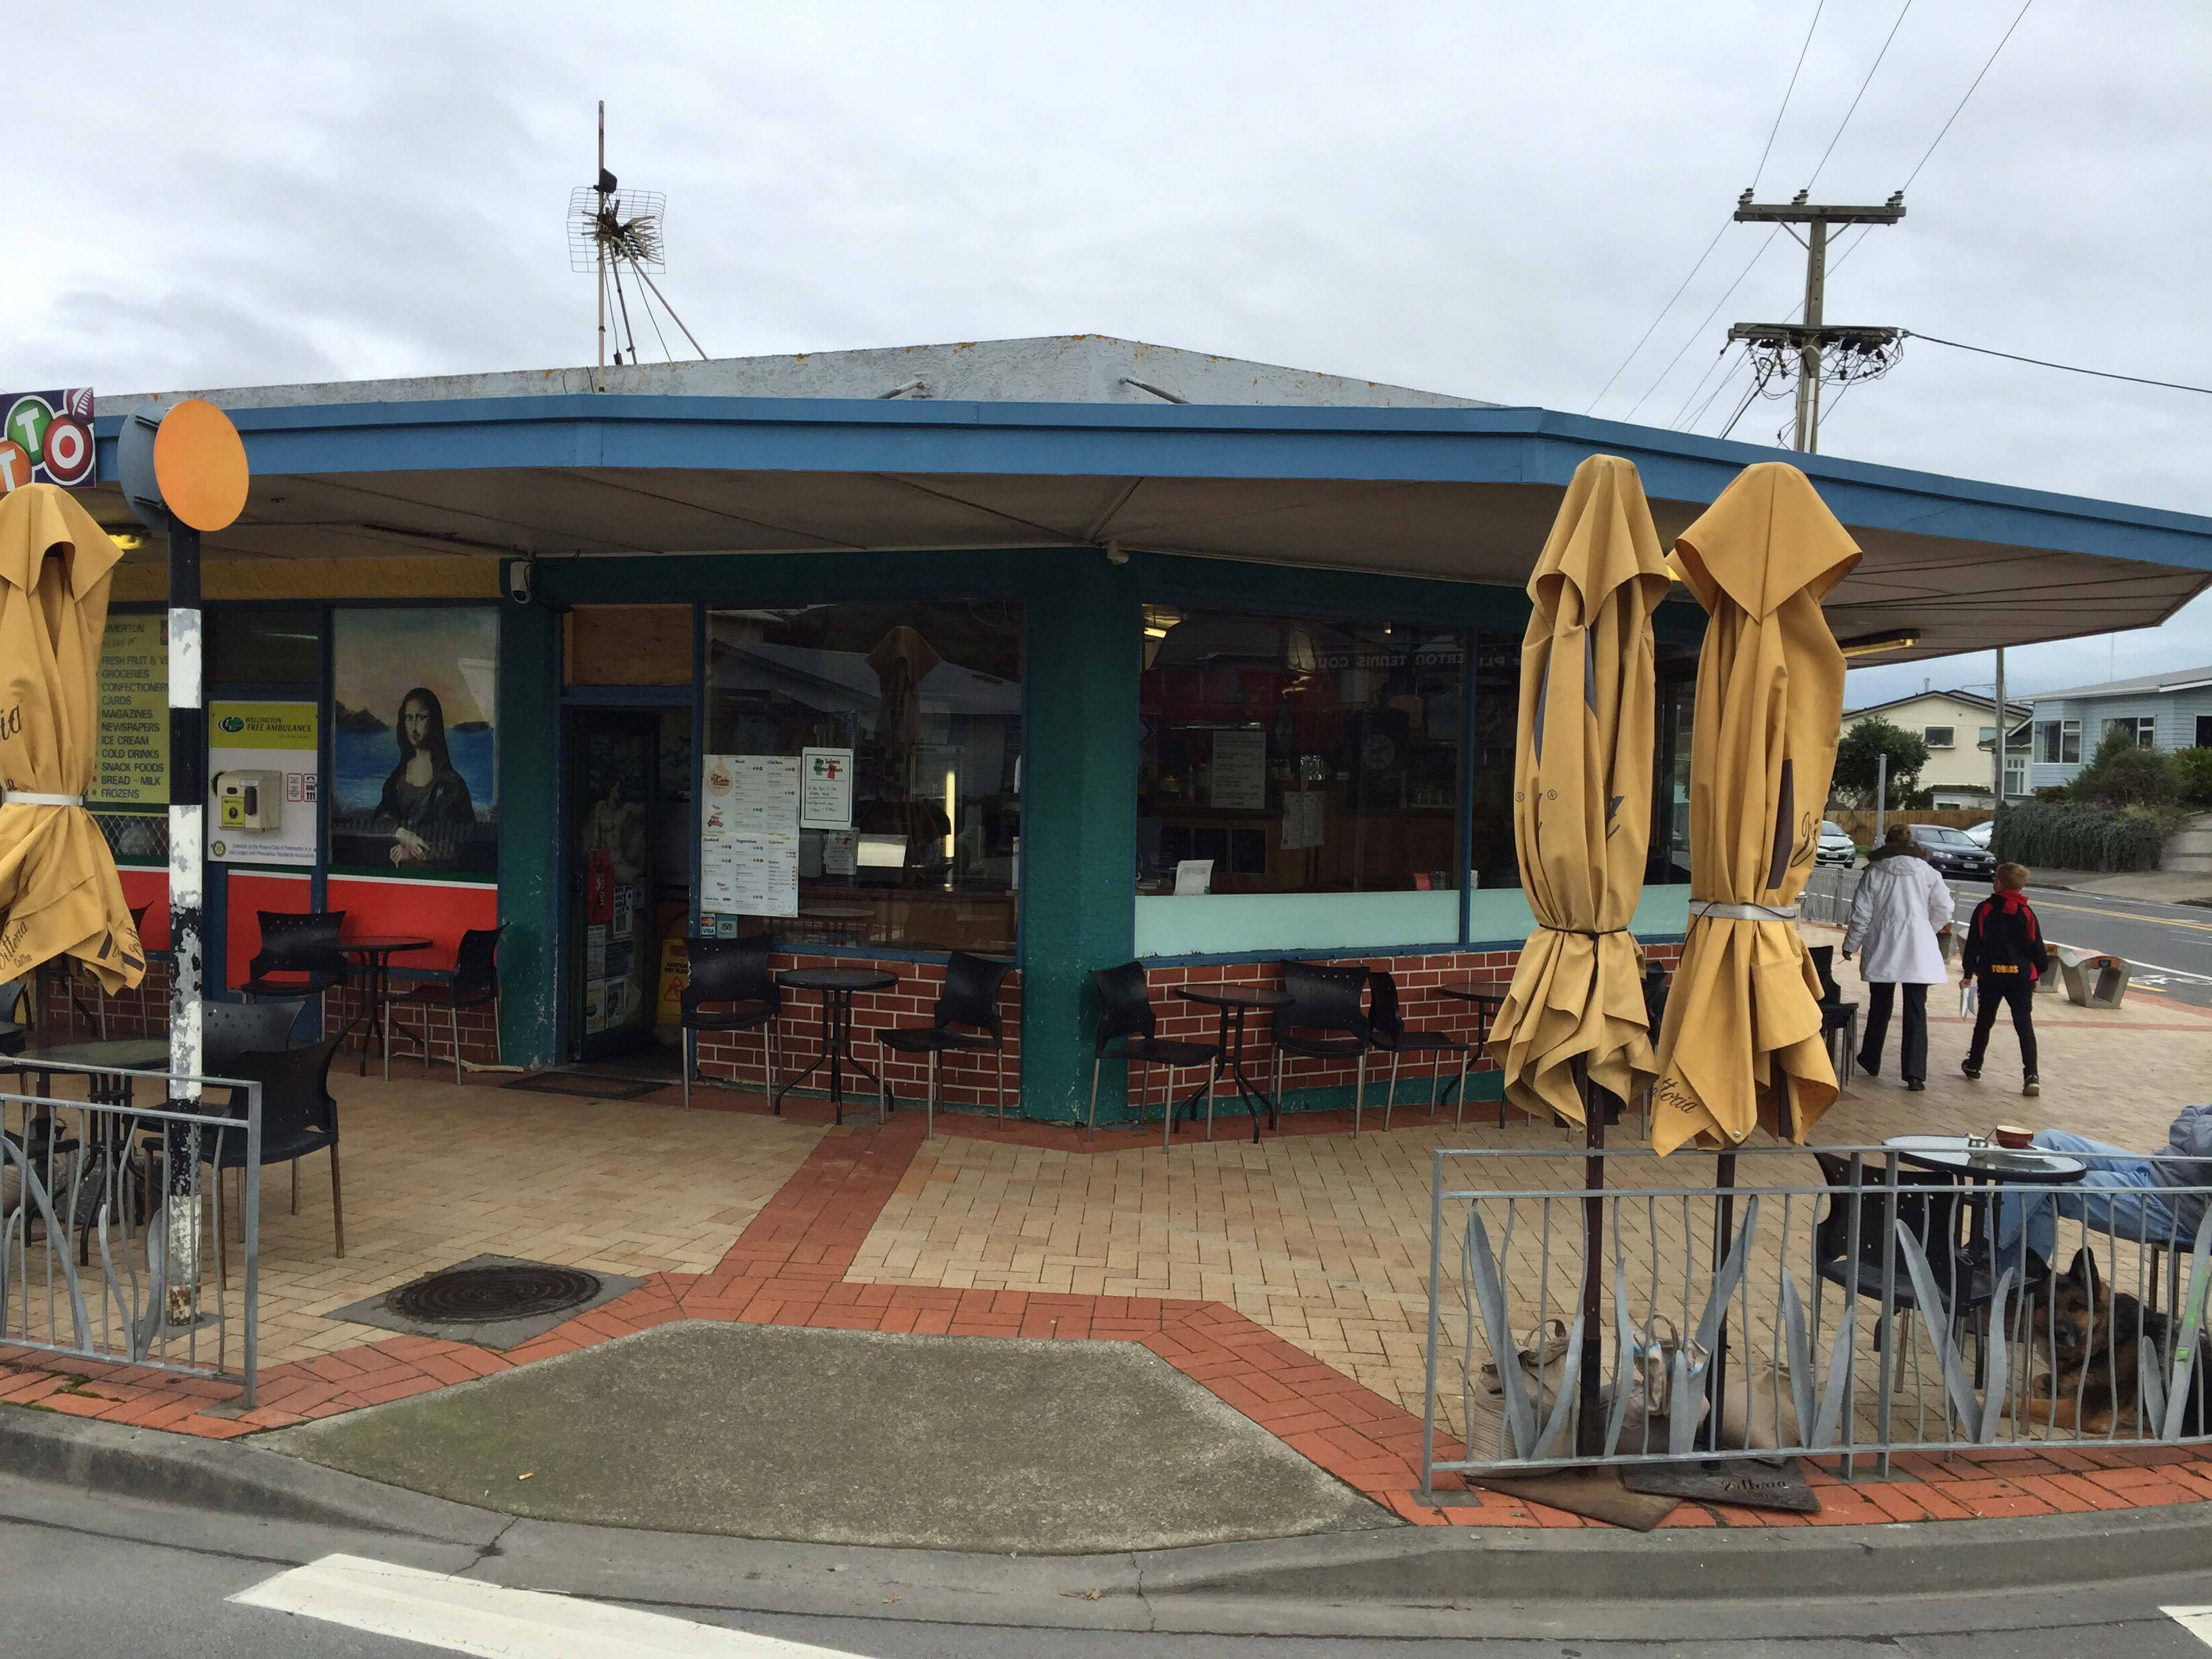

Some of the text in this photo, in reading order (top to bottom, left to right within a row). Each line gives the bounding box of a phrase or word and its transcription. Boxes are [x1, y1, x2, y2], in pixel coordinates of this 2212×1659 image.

[102, 656, 124, 665] FRESH
[127, 656, 148, 665] FRUIT
[102, 669, 150, 678] GROCERIES
[102, 695, 131, 705] CARDS
[102, 710, 152, 718] MAGAZINES
[102, 722, 160, 732] NEWSPAPERS
[266, 724, 312, 733] AMBULANCE
[102, 736, 149, 745] ICE CREAM
[102, 749, 159, 759] COLD DRINKS
[102, 762, 164, 773] SNACK FOODS
[101, 775, 130, 785] BREAD
[140, 777, 161, 785] MILK
[101, 789, 140, 798] FROZENS
[1991, 964, 2020, 975] TOBIAS
